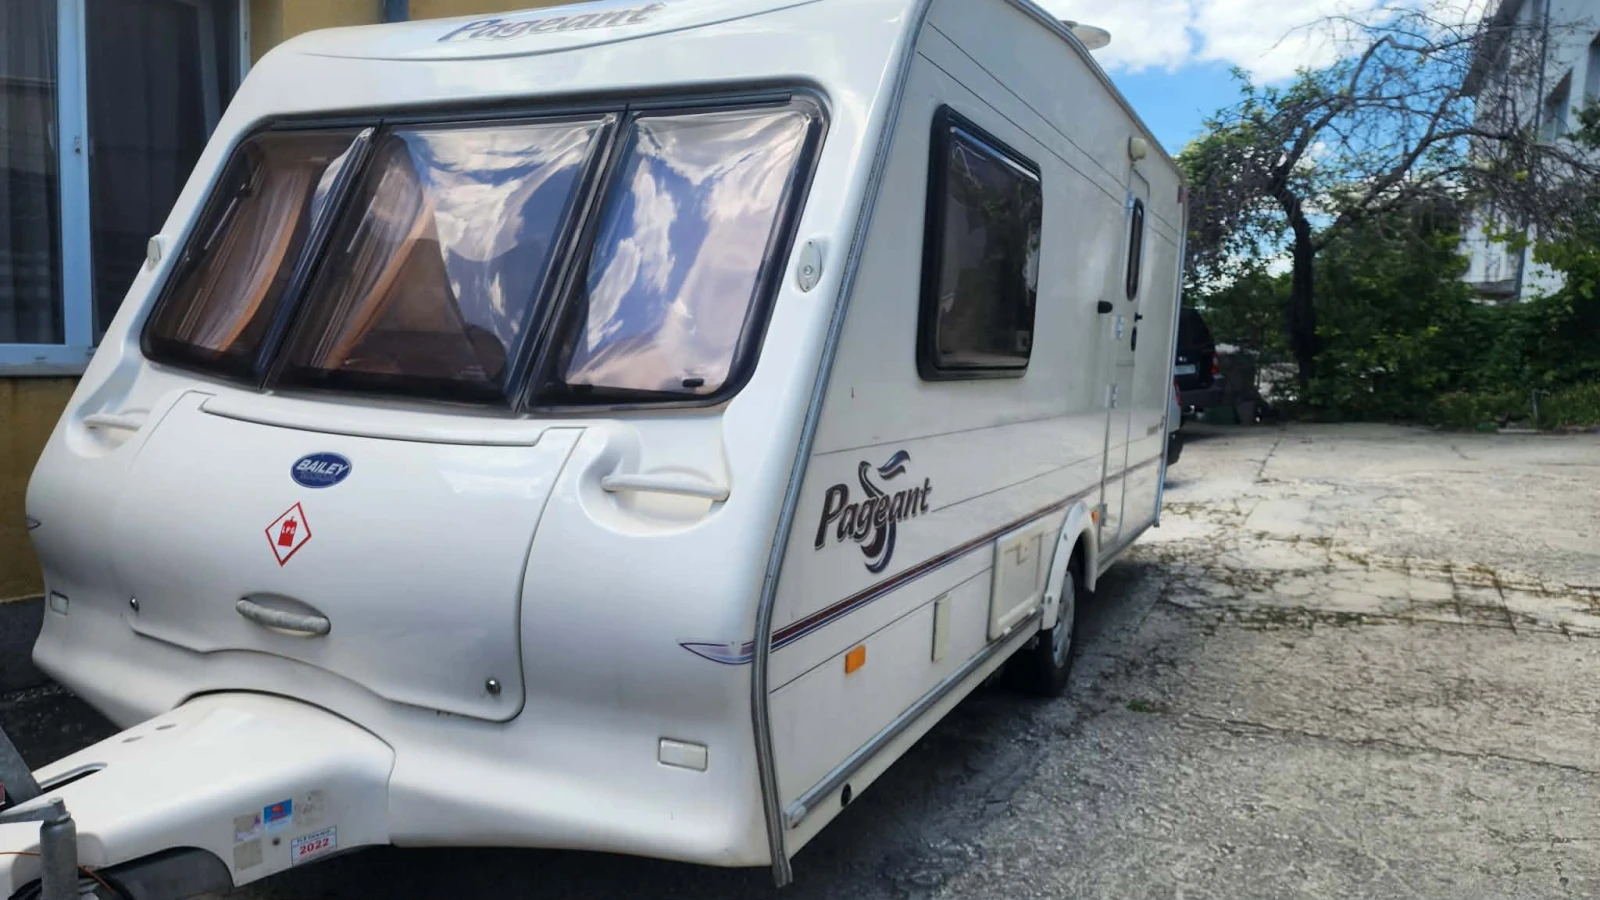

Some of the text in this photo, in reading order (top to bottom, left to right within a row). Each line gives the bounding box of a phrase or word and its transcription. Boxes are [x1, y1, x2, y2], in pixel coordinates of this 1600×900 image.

[437, 2, 667, 43] Pageant
[296, 459, 349, 476] BAILEY
[815, 477, 932, 551] Pageant
[299, 837, 330, 855] 2022
